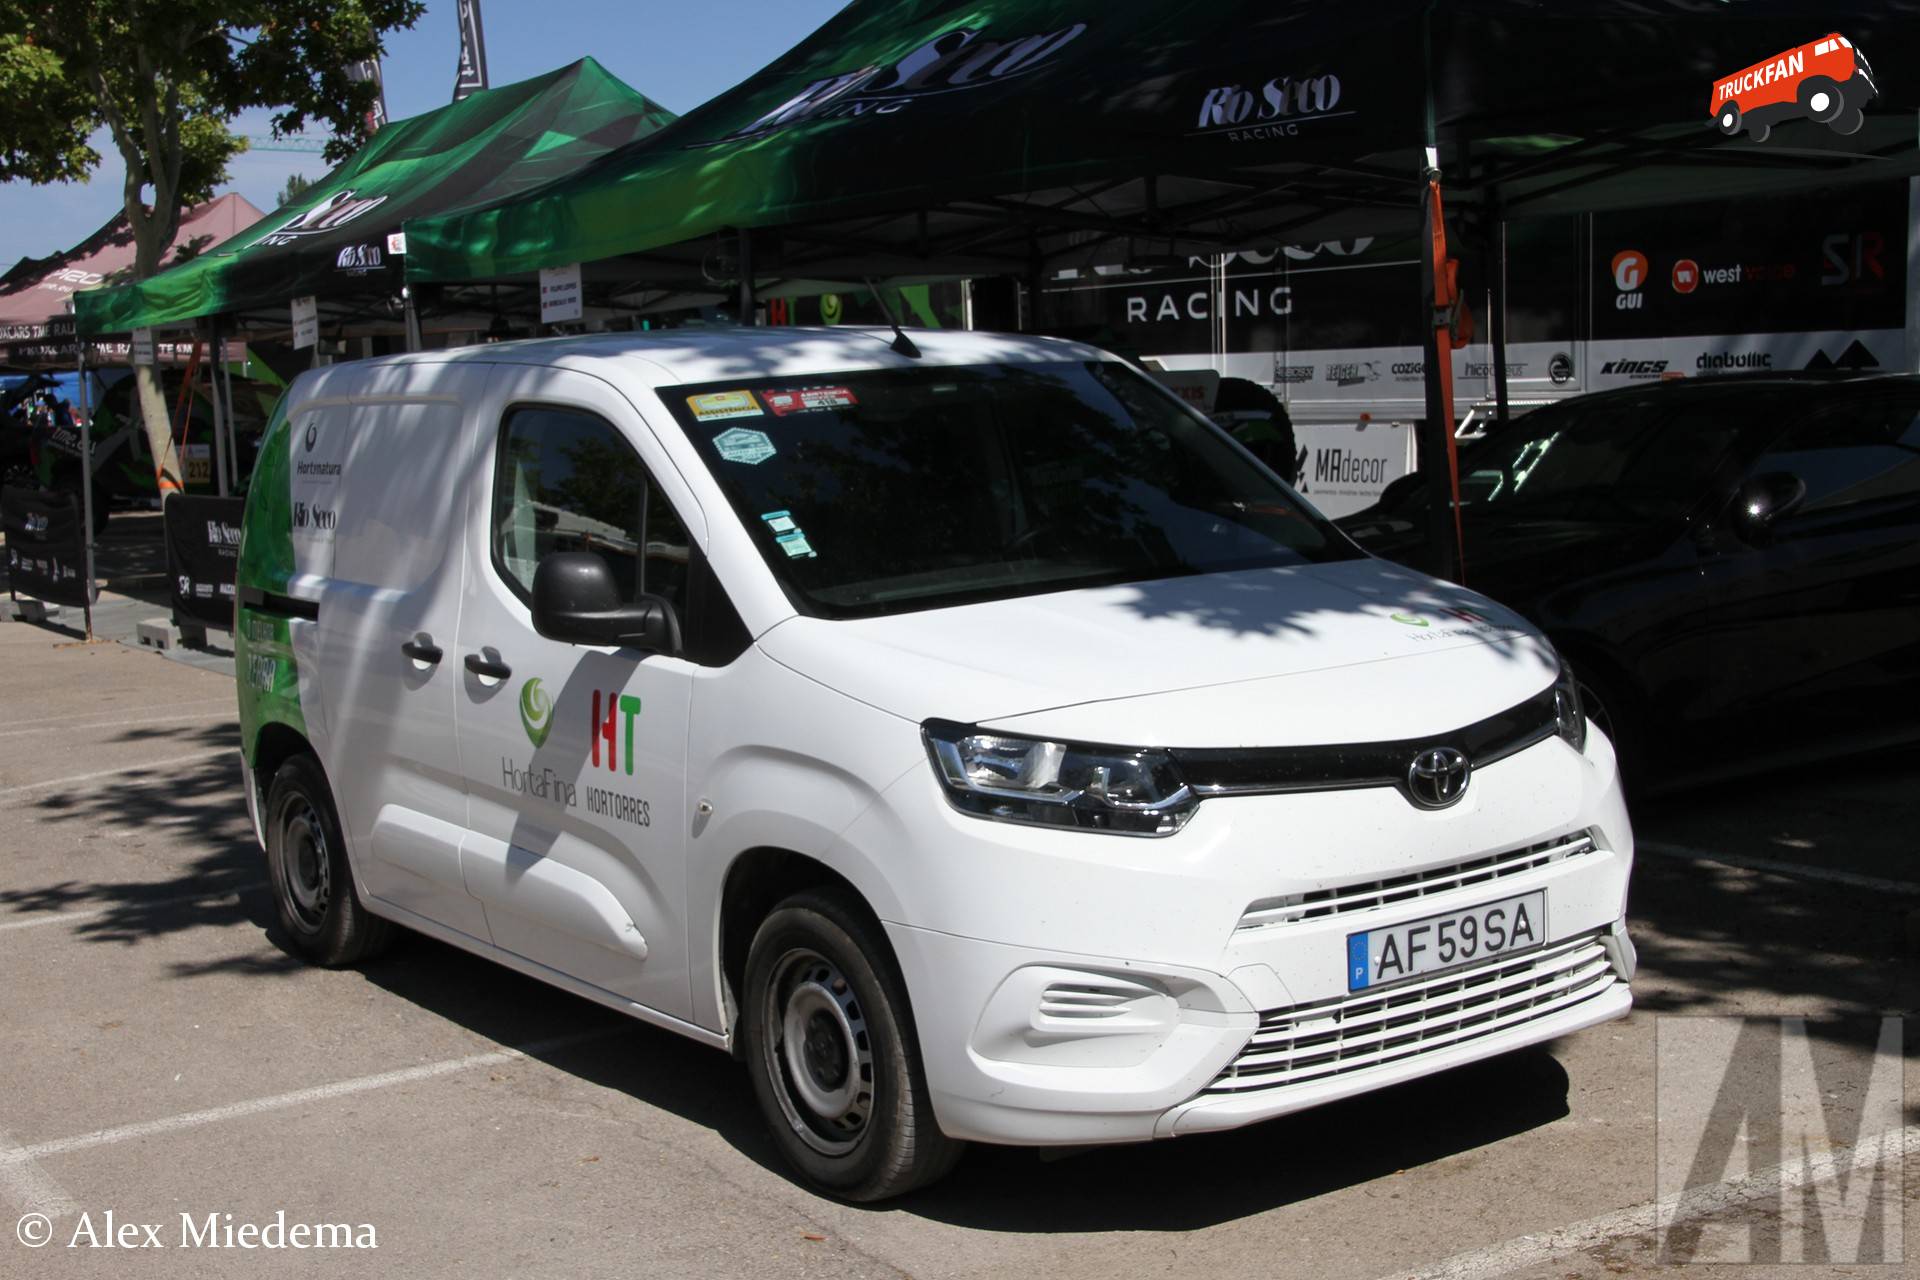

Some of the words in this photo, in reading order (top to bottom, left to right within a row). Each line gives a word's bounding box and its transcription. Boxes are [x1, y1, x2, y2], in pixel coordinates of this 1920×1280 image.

[1227, 124, 1300, 143] RACING
[1703, 264, 1742, 284] west
[1127, 286, 1293, 323] RACING
[1616, 293, 1643, 310] GUI
[188, 461, 209, 478] 212
[592, 689, 641, 776] HT
[502, 756, 577, 807] HortaFina
[586, 785, 651, 828] HORTORRES
[1355, 967, 1364, 980] P
